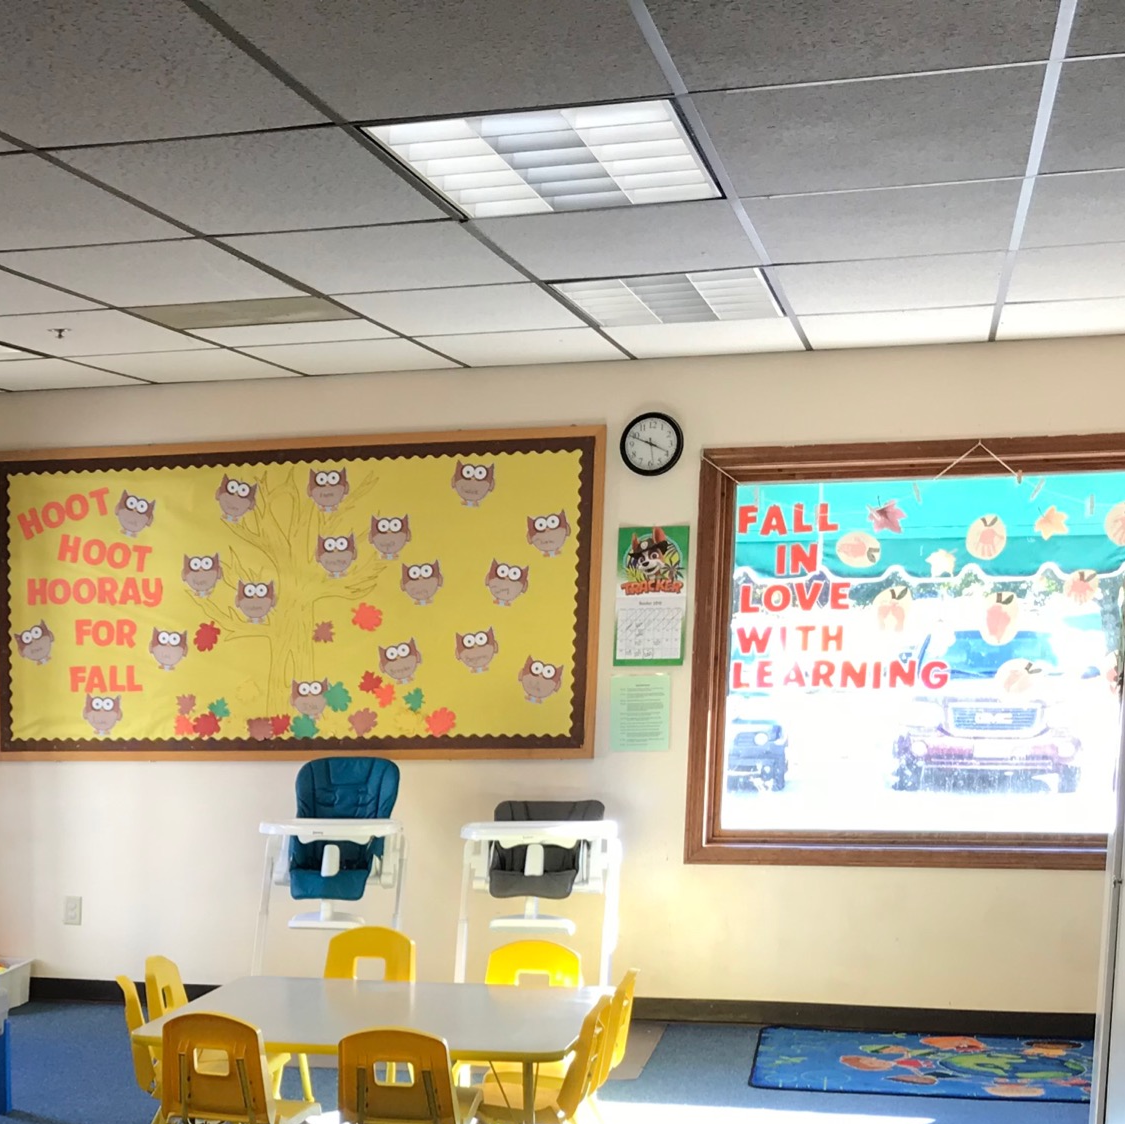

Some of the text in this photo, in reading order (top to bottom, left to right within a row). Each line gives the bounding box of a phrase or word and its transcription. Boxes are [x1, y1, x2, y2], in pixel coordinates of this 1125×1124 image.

[17, 487, 110, 540] HOOT
[737, 503, 839, 536] FALL
[57, 534, 153, 572] HOOT
[775, 542, 818, 575] IN
[27, 577, 163, 608] HOORAY
[620, 579, 684, 596] TRACKER
[739, 581, 851, 613] LOVE
[74, 619, 138, 648] FOR
[736, 624, 844, 654] WITH
[69, 665, 143, 693] FALL
[732, 659, 949, 690] LEARNING
